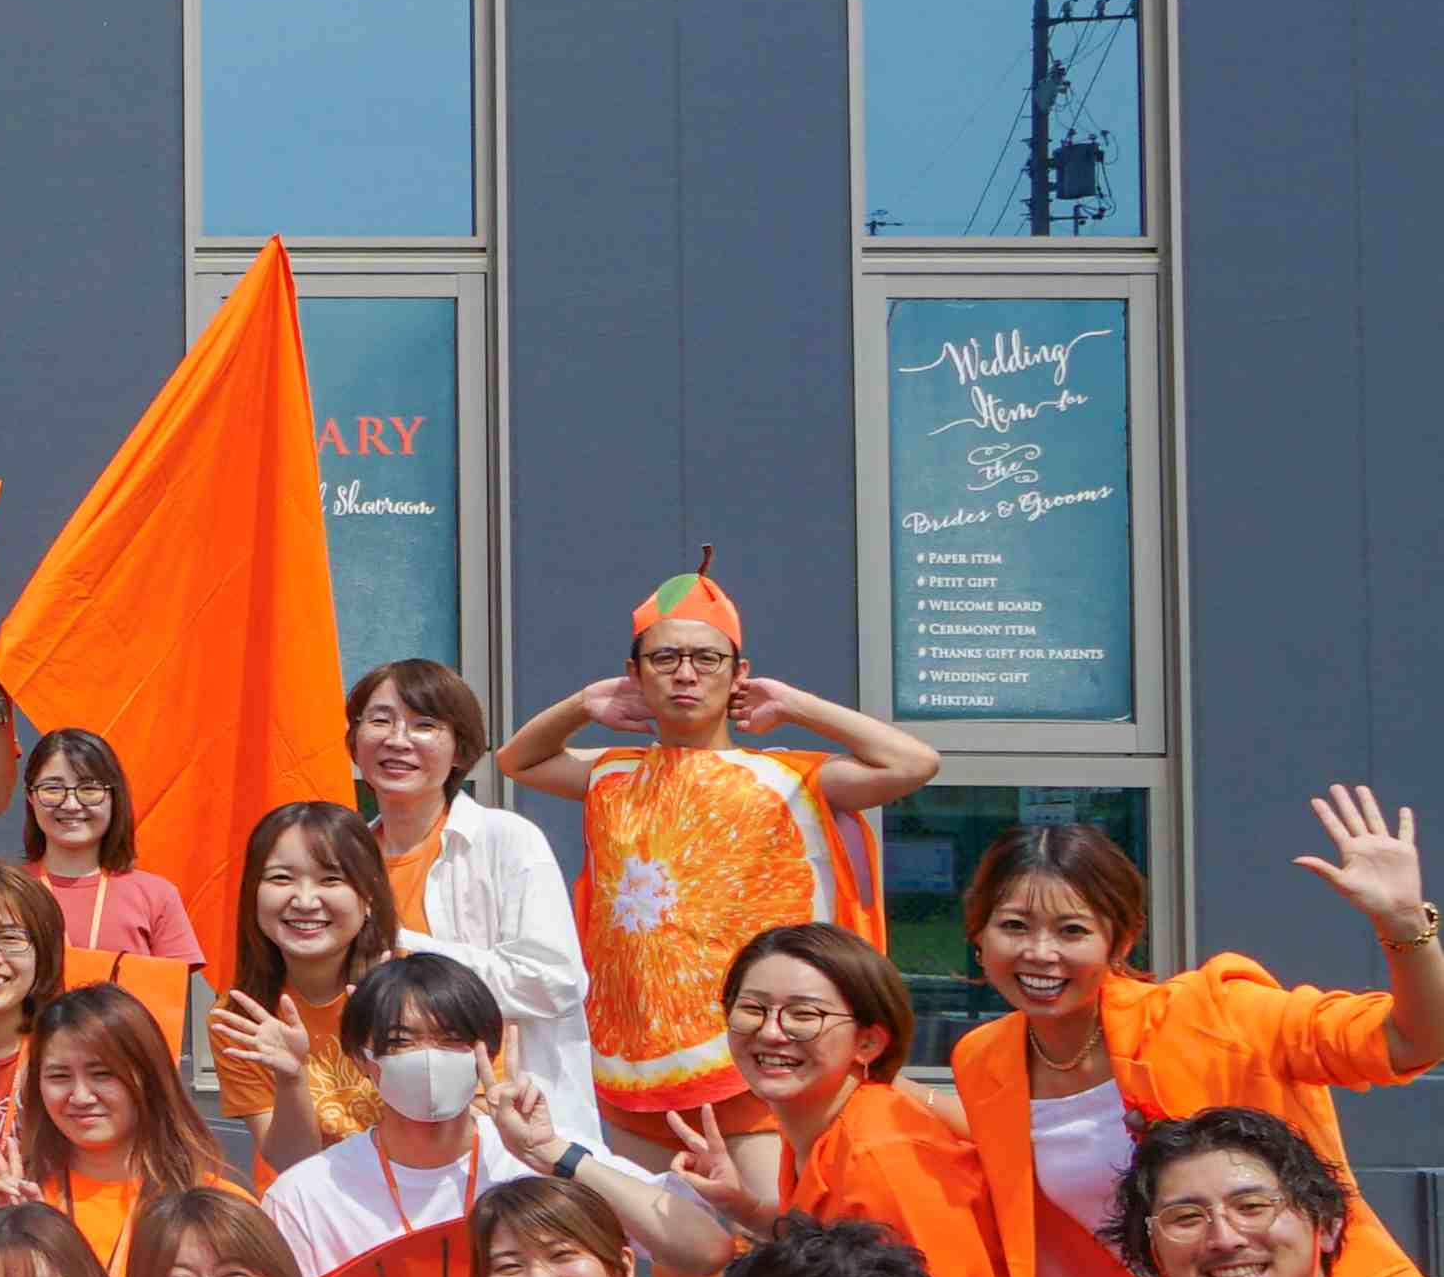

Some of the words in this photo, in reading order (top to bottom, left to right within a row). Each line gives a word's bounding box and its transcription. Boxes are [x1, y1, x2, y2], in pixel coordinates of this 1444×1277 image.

[899, 329, 1113, 385] Wedding
[932, 386, 1040, 434] Item
[319, 416, 423, 455] ARY
[333, 479, 436, 515] Showroom
[902, 508, 992, 535] Brides
[997, 501, 1015, 518] &
[1019, 485, 1113, 521] Grooms
